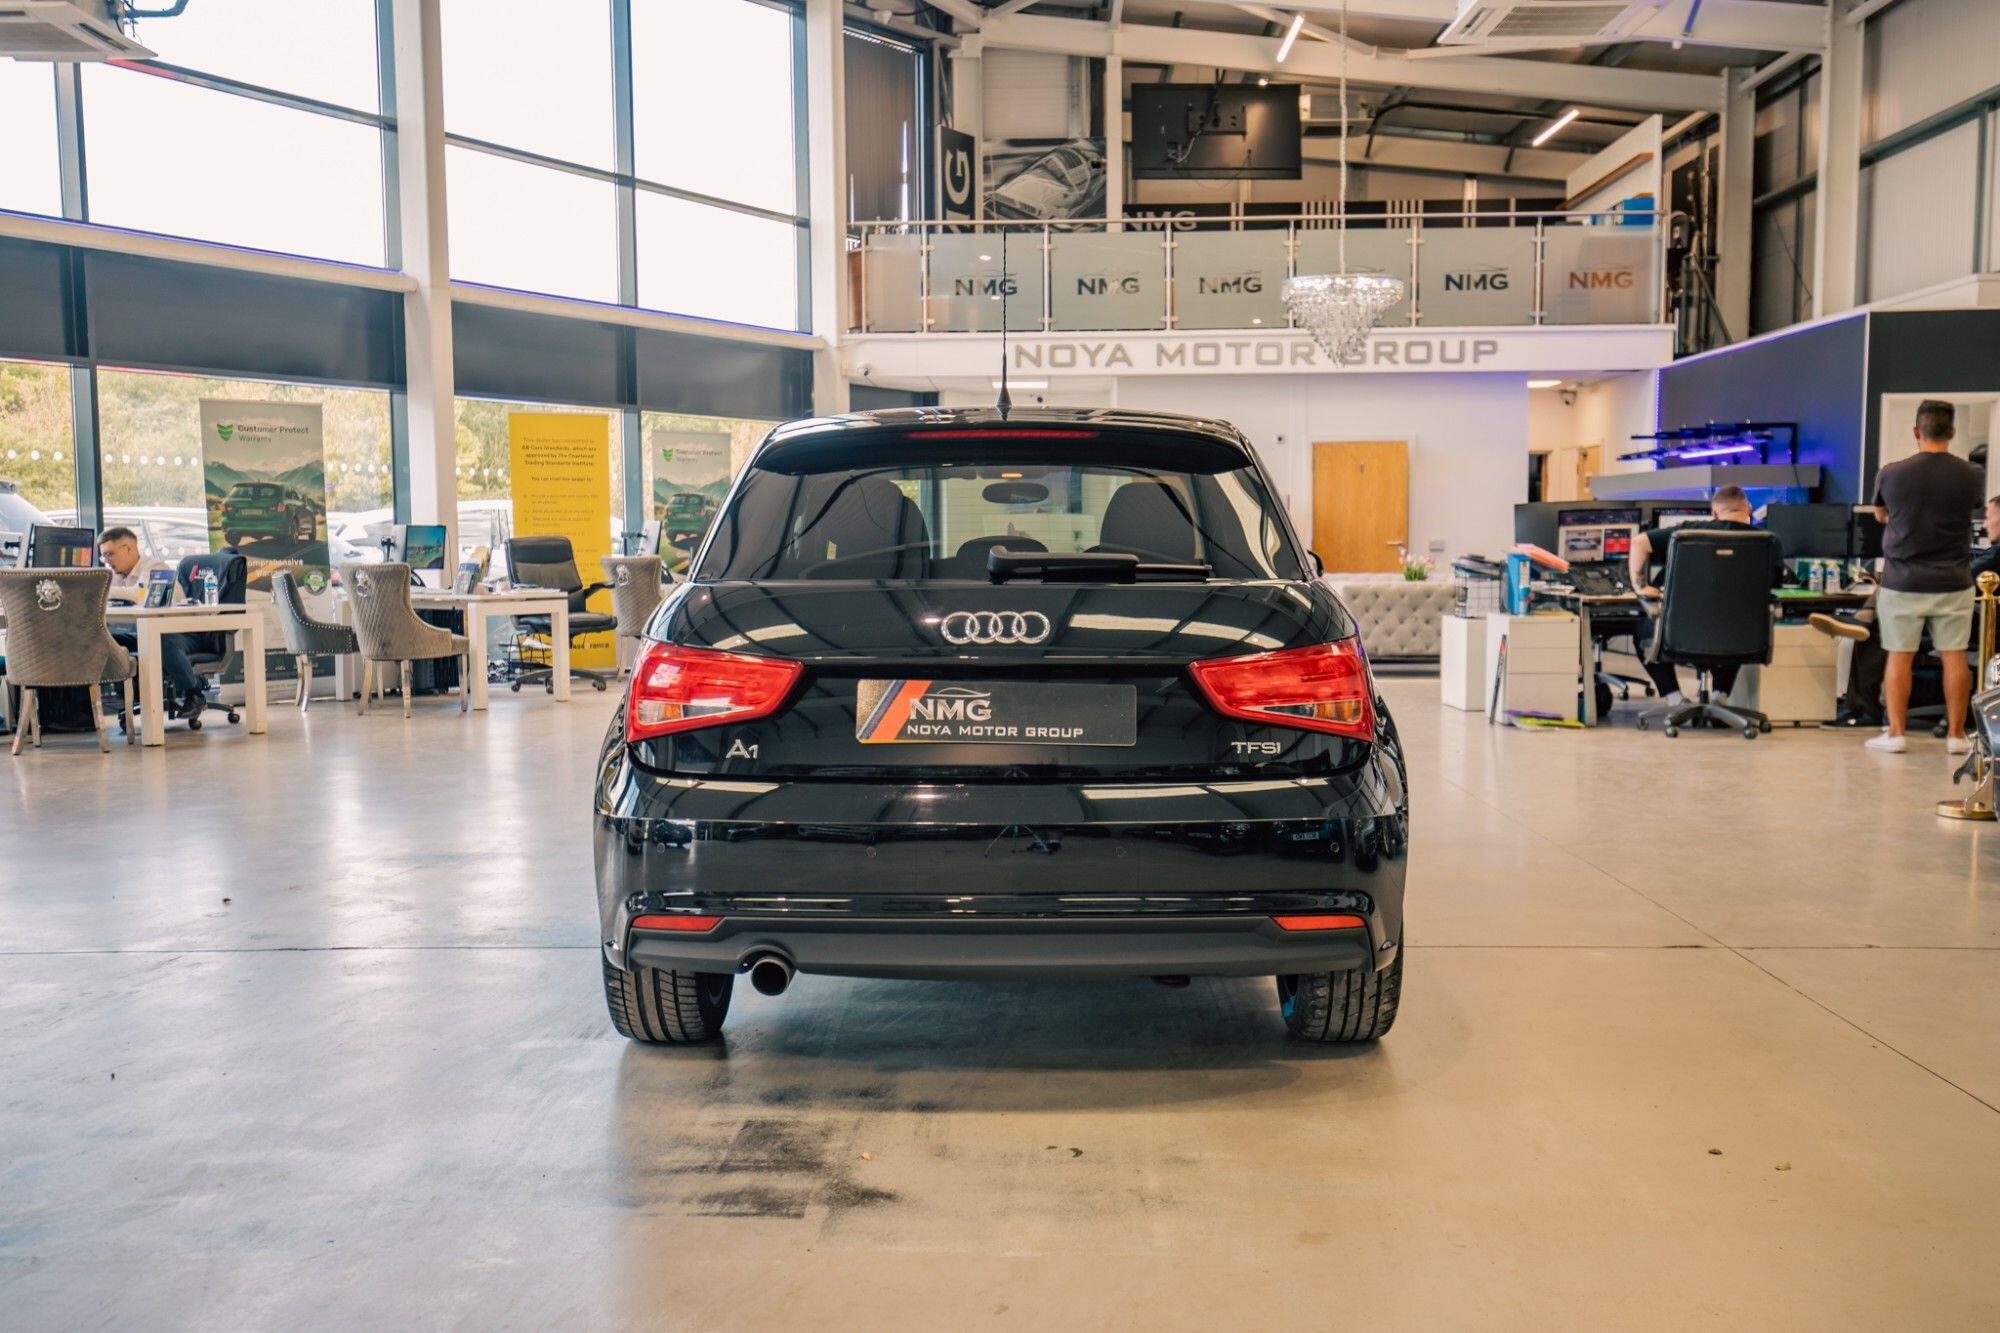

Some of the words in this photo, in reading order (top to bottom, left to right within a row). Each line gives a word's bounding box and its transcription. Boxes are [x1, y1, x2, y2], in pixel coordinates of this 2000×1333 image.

[1122, 211, 1197, 231] NMG
[955, 278, 1018, 296] NMG
[1077, 277, 1140, 295] NMG
[1199, 277, 1262, 294] NMG
[1445, 273, 1509, 291] NMG
[1569, 271, 1633, 289] NMG
[1015, 343, 1133, 368] NOYA
[1156, 341, 1316, 367] MOTOR
[1340, 340, 1498, 366] GROUP
[238, 424, 278, 433] Customer
[280, 426, 309, 434] Protect
[247, 558, 304, 568] omprehensive
[909, 698, 992, 721] NMG
[907, 724, 951, 736] NOYA
[959, 725, 1018, 737] MOTOR
[1025, 727, 1084, 738] GROUP
[725, 739, 759, 759] A1
[1230, 741, 1281, 755] TFSI
